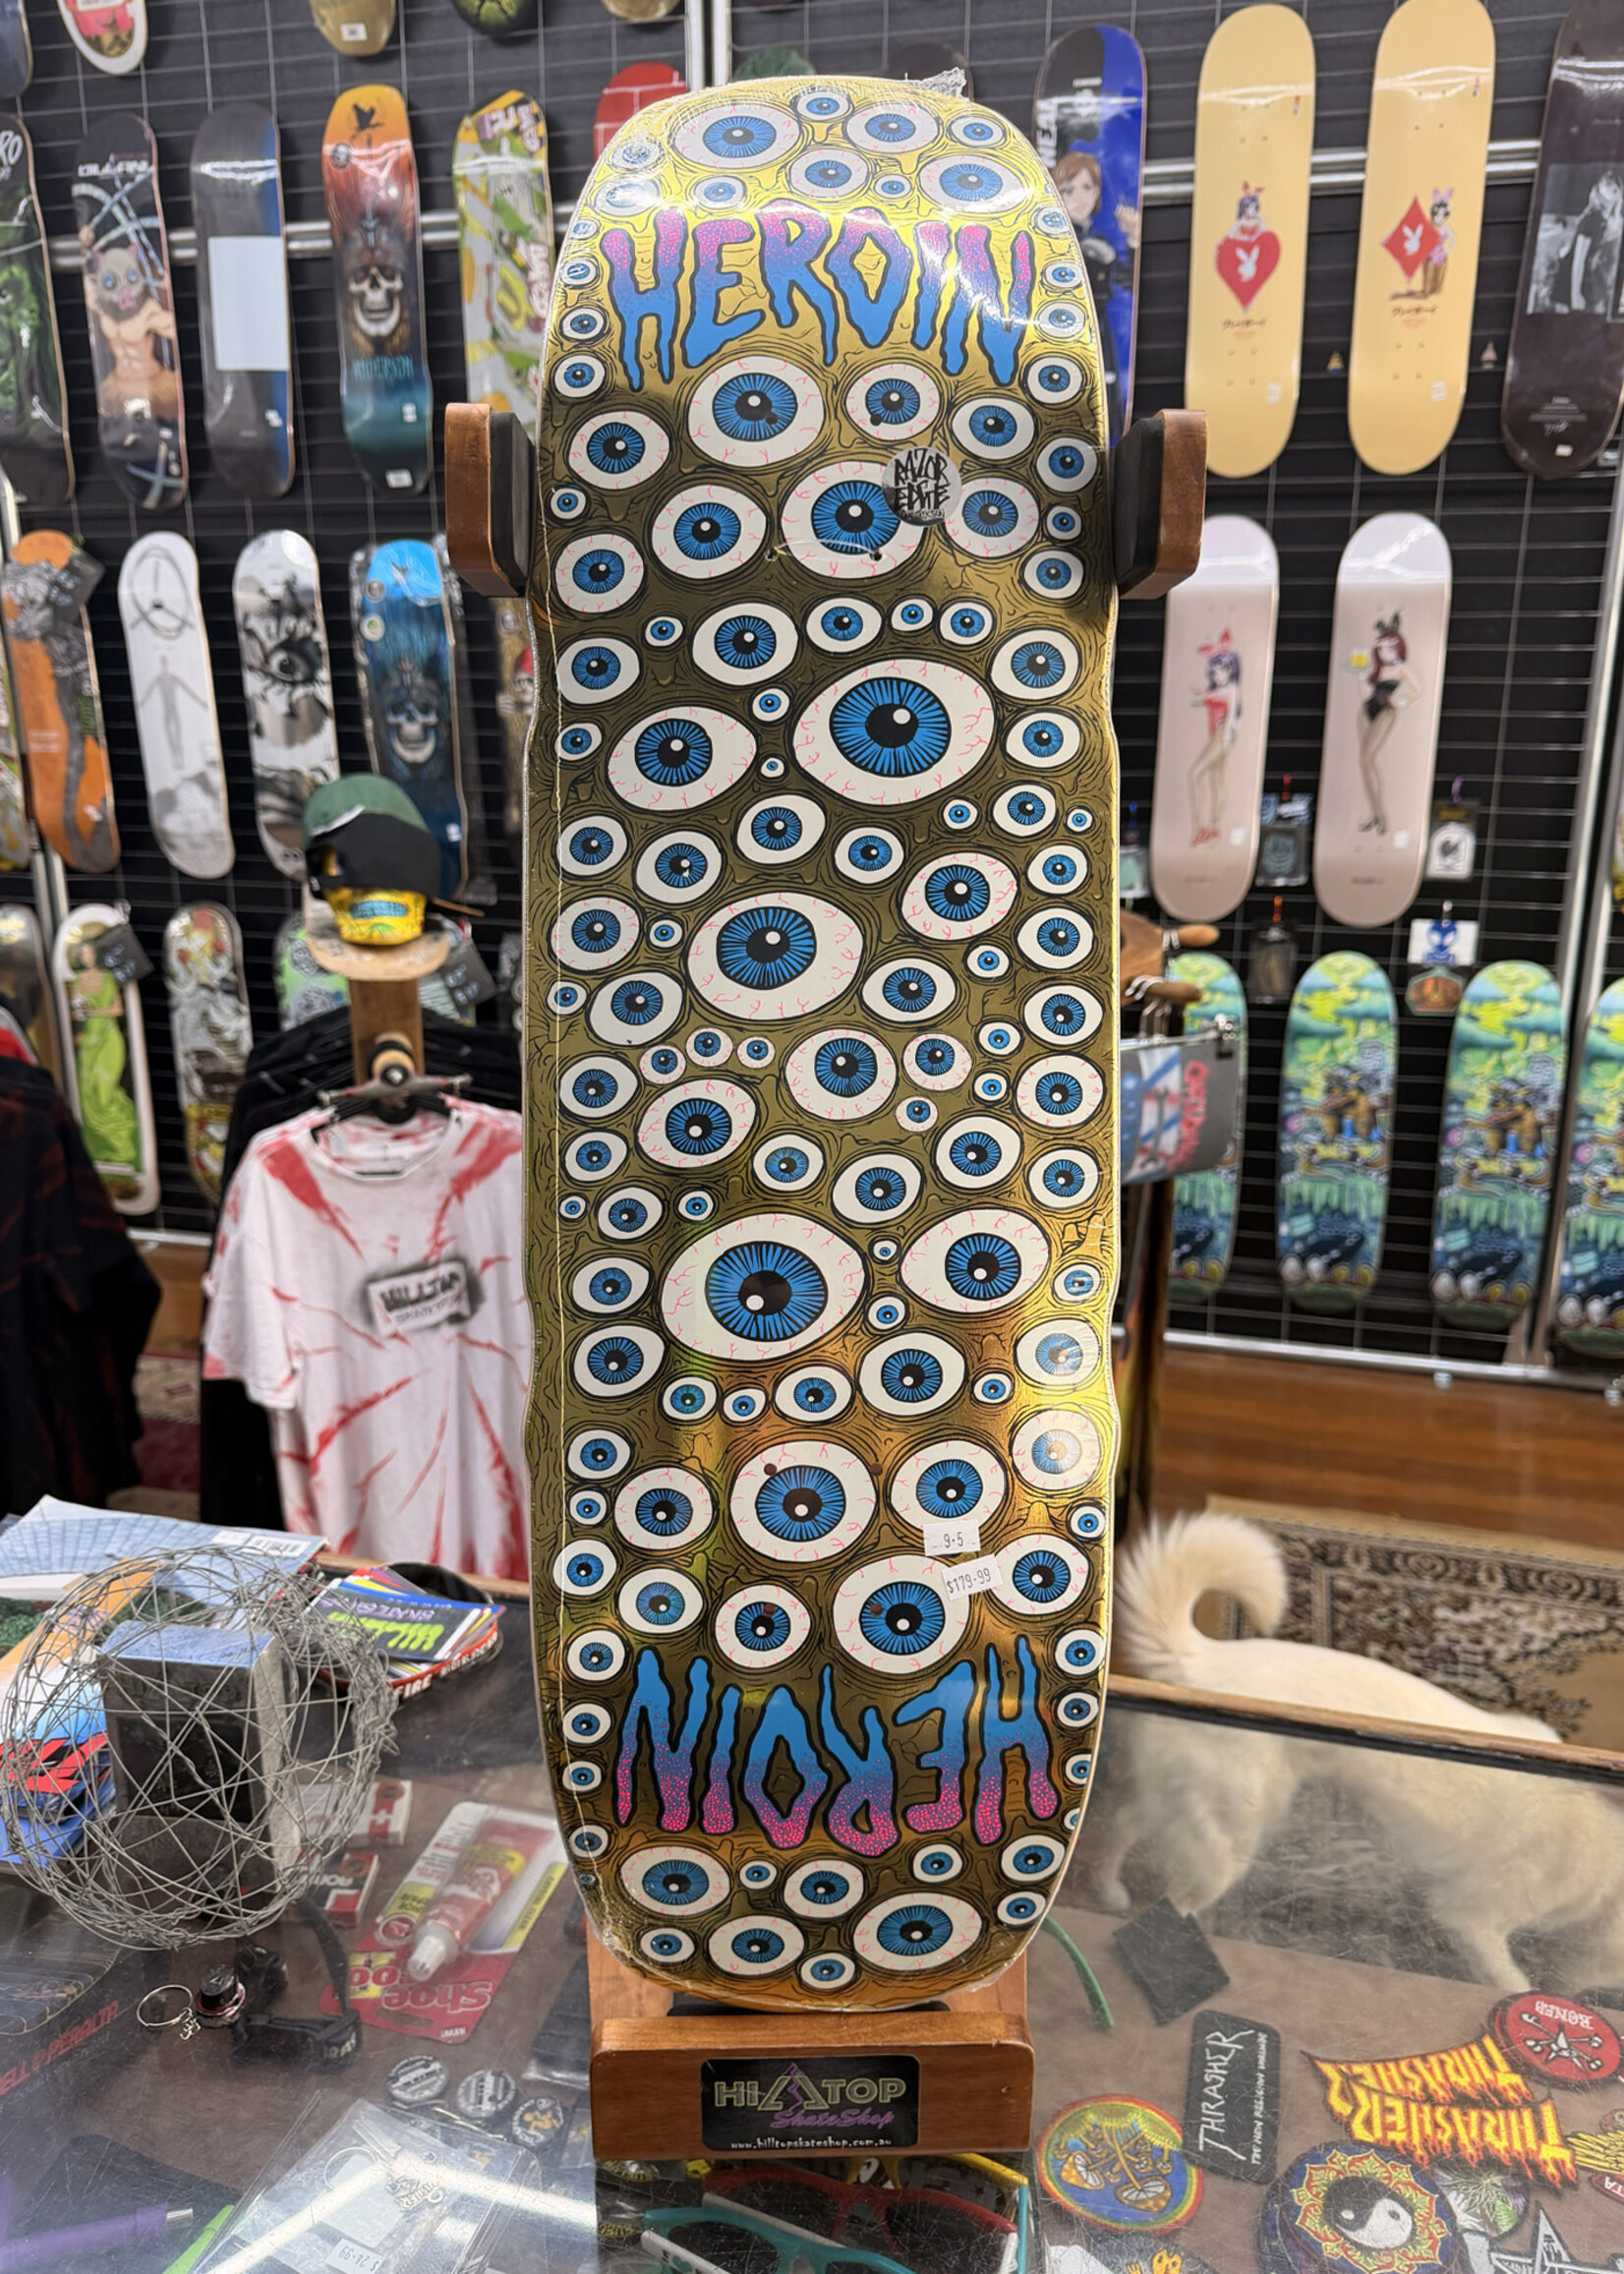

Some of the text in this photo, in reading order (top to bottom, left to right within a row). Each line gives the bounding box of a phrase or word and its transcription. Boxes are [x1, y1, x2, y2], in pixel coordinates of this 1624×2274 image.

[601, 199, 1036, 391] HEROIN
[895, 447, 949, 487] RAZOR
[895, 480, 952, 510] EDGE
[943, 1531, 964, 1549] 9.5
[946, 1567, 992, 1595] $179.99
[614, 1636, 1061, 1856] HEROIN
[381, 1981, 493, 2013] Shoe
[1198, 2029, 1255, 2161] THRASHER
[730, 2135, 892, 2150] www.hilltopskateshop.com.au
[1350, 2098, 1577, 2187] THRASHER
